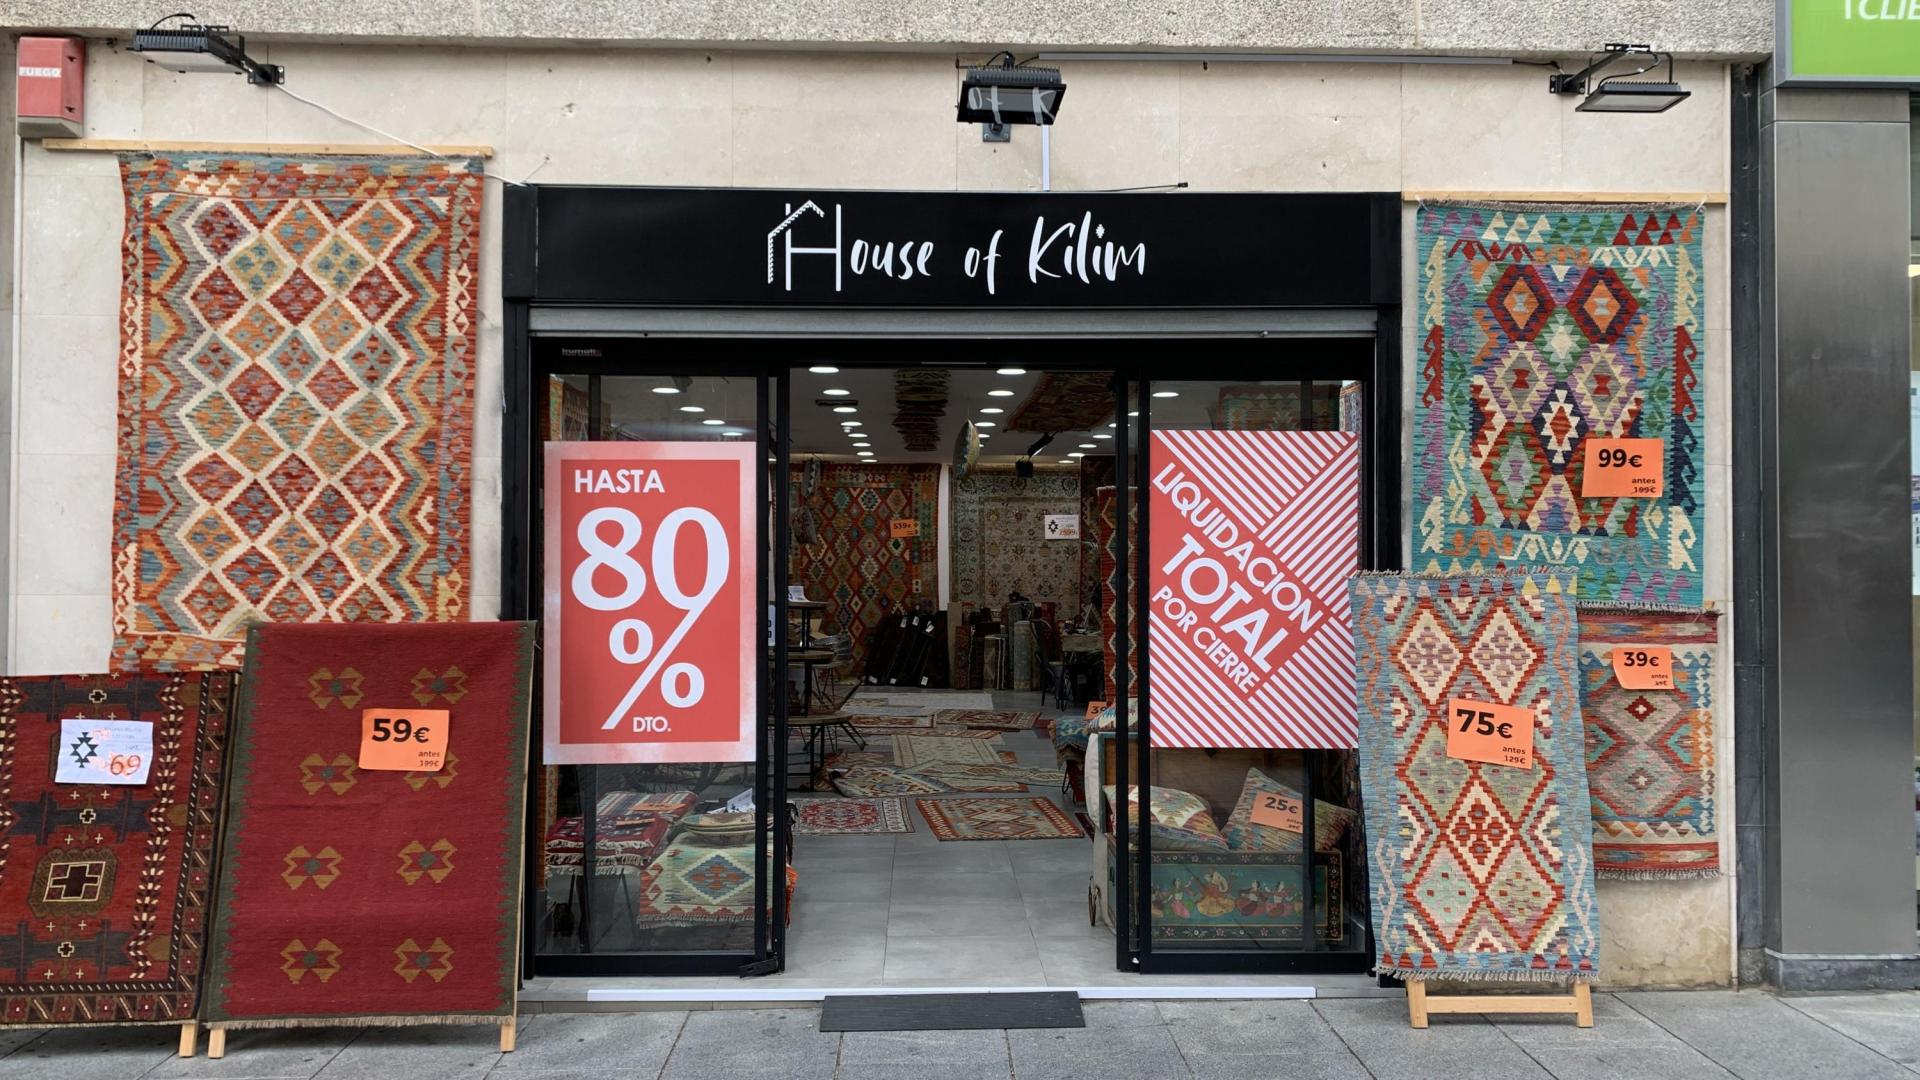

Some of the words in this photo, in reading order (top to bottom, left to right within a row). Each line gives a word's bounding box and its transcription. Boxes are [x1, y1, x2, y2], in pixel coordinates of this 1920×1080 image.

[768, 200, 934, 291] House
[965, 230, 1003, 295] of
[1028, 211, 1146, 284] Kilim
[1598, 448, 1642, 468] 99€
[575, 470, 665, 493] HASTA
[571, 506, 730, 612] 80
[1152, 462, 1324, 633] LIQUIDACION
[1162, 533, 1289, 673] TOTAL
[1152, 585, 1198, 633] POR
[1193, 626, 1261, 694] CIERRE
[1623, 651, 1659, 667] 39€
[371, 718, 430, 743] 59€
[632, 716, 672, 732] DTO.
[1456, 708, 1513, 739] 75€
[1502, 746, 1526, 754] antes
[1504, 755, 1526, 764] 129€
[110, 754, 141, 775] 69
[1264, 796, 1298, 814] 25€
